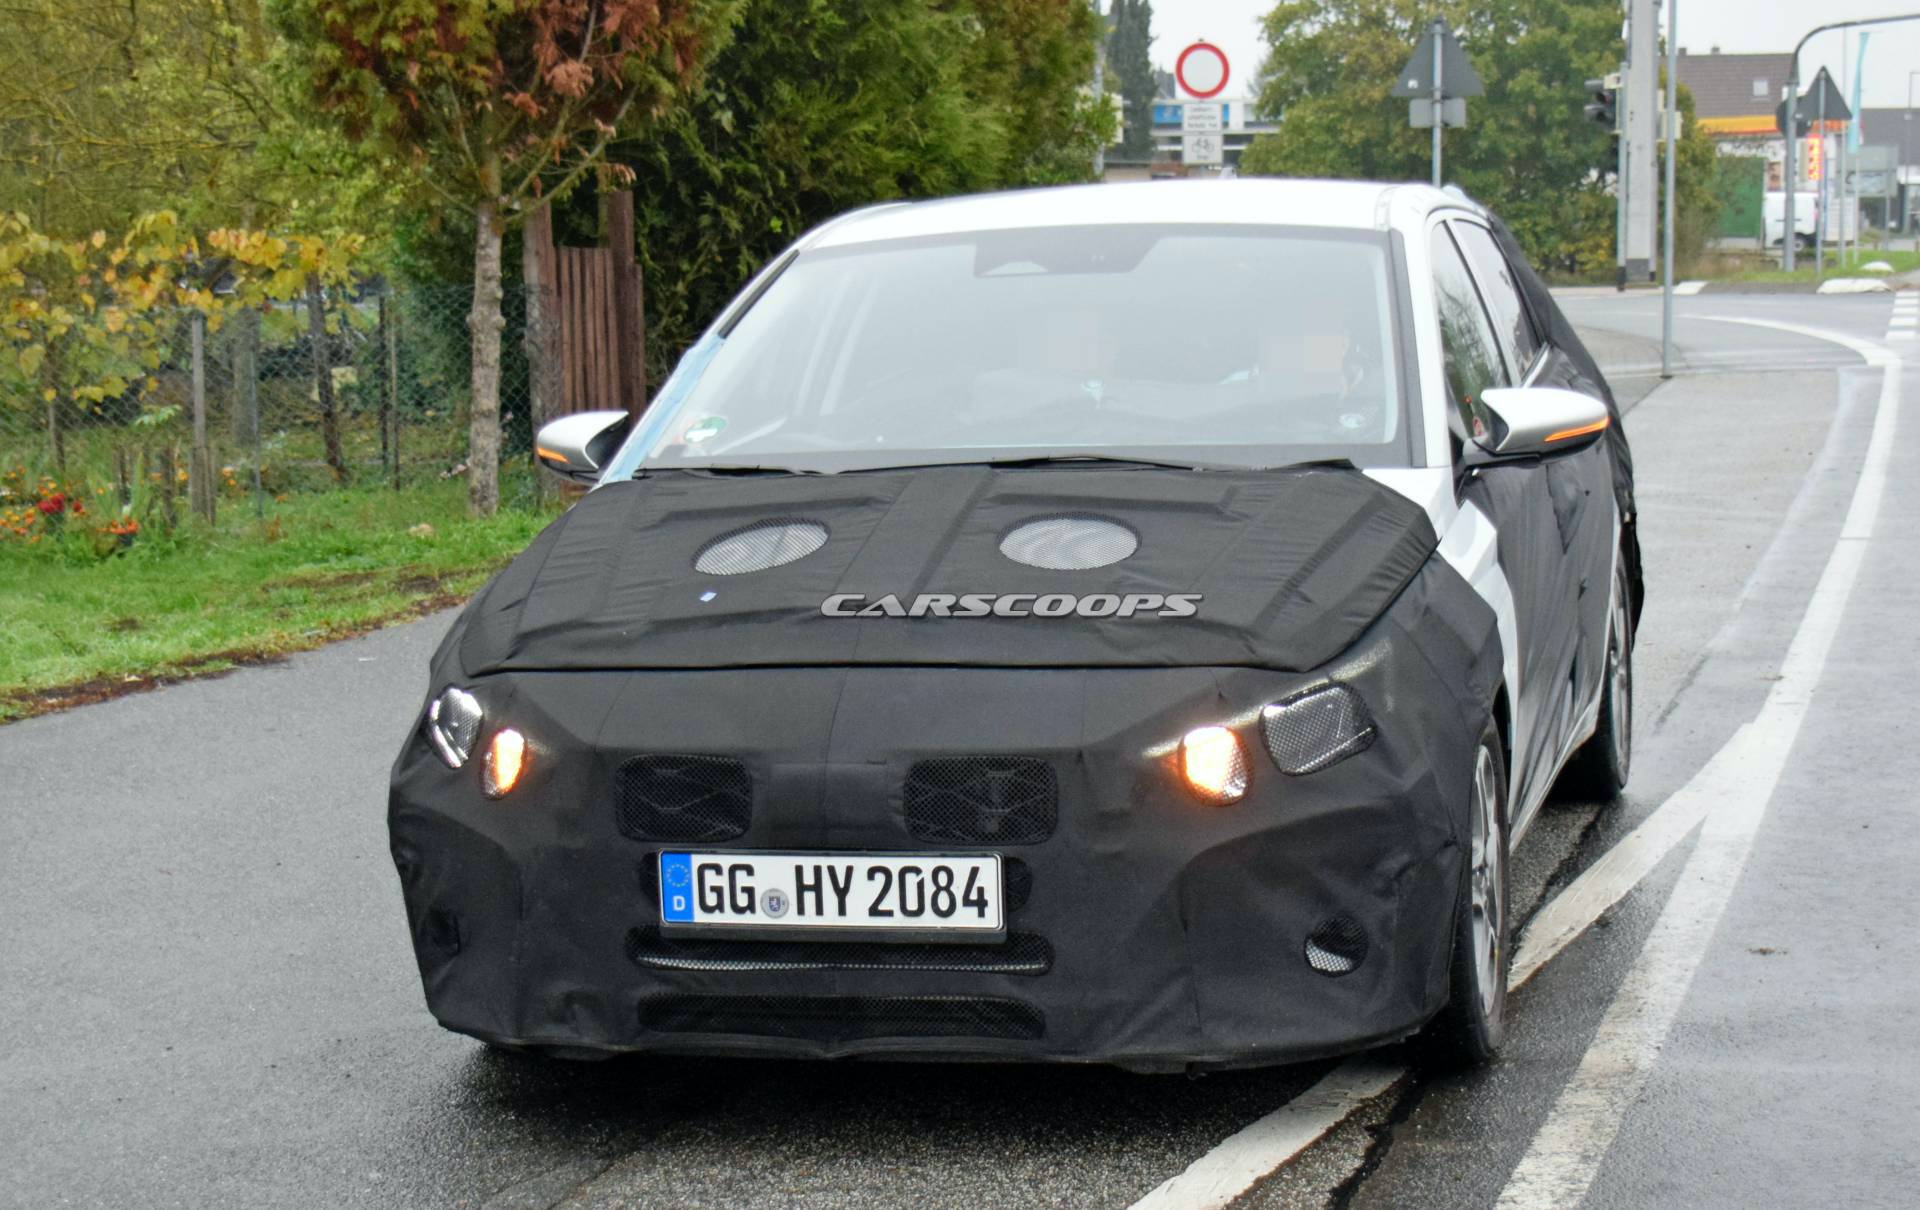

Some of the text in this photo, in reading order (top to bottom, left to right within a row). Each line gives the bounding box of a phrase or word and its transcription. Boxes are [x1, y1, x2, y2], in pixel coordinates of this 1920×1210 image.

[672, 895, 685, 911] D
[697, 863, 988, 918] GG HY 2084
